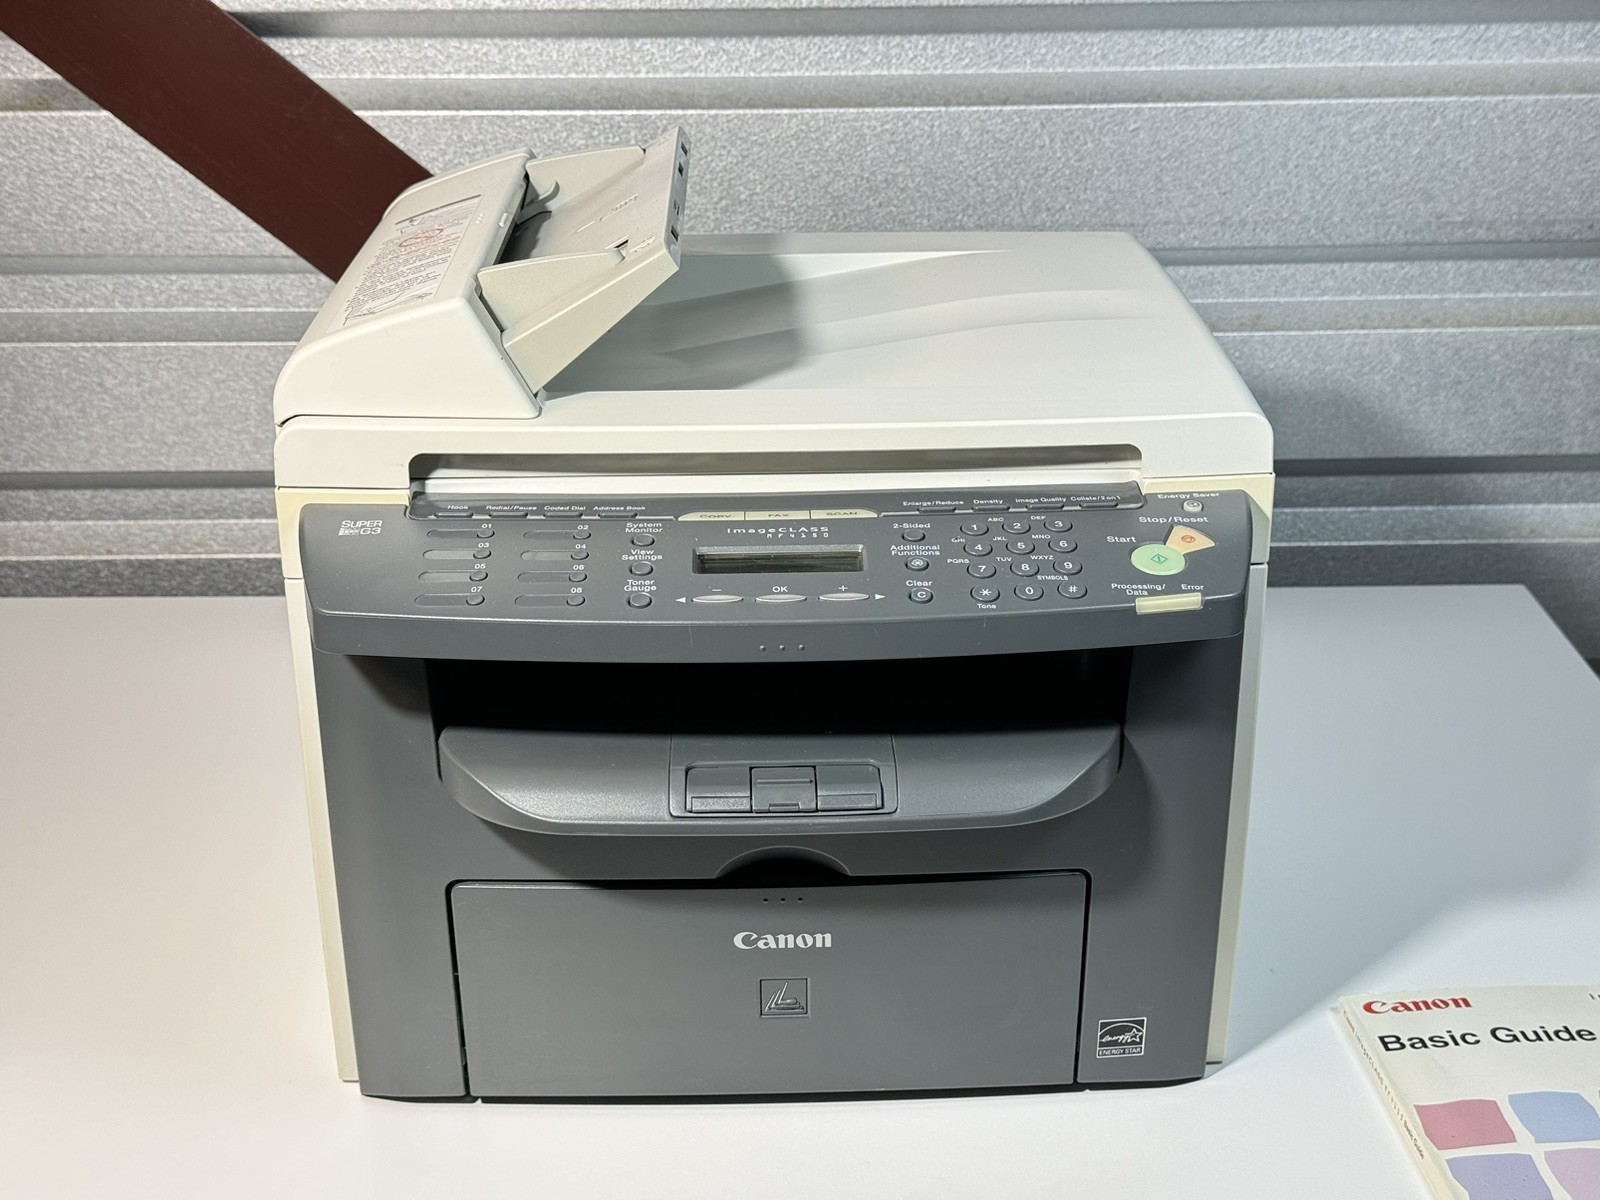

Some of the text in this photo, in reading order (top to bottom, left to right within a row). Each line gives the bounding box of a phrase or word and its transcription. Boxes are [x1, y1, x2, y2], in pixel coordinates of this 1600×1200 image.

[1059, 540, 1069, 548] 6
[1021, 563, 1030, 571] 8
[624, 584, 657, 592] Gauge
[1025, 587, 1034, 595] 0
[1111, 583, 1166, 591] Processing/
[733, 931, 832, 950] Canon
[1362, 996, 1472, 1014] Canon
[1377, 1025, 1597, 1052] Basic Guide
